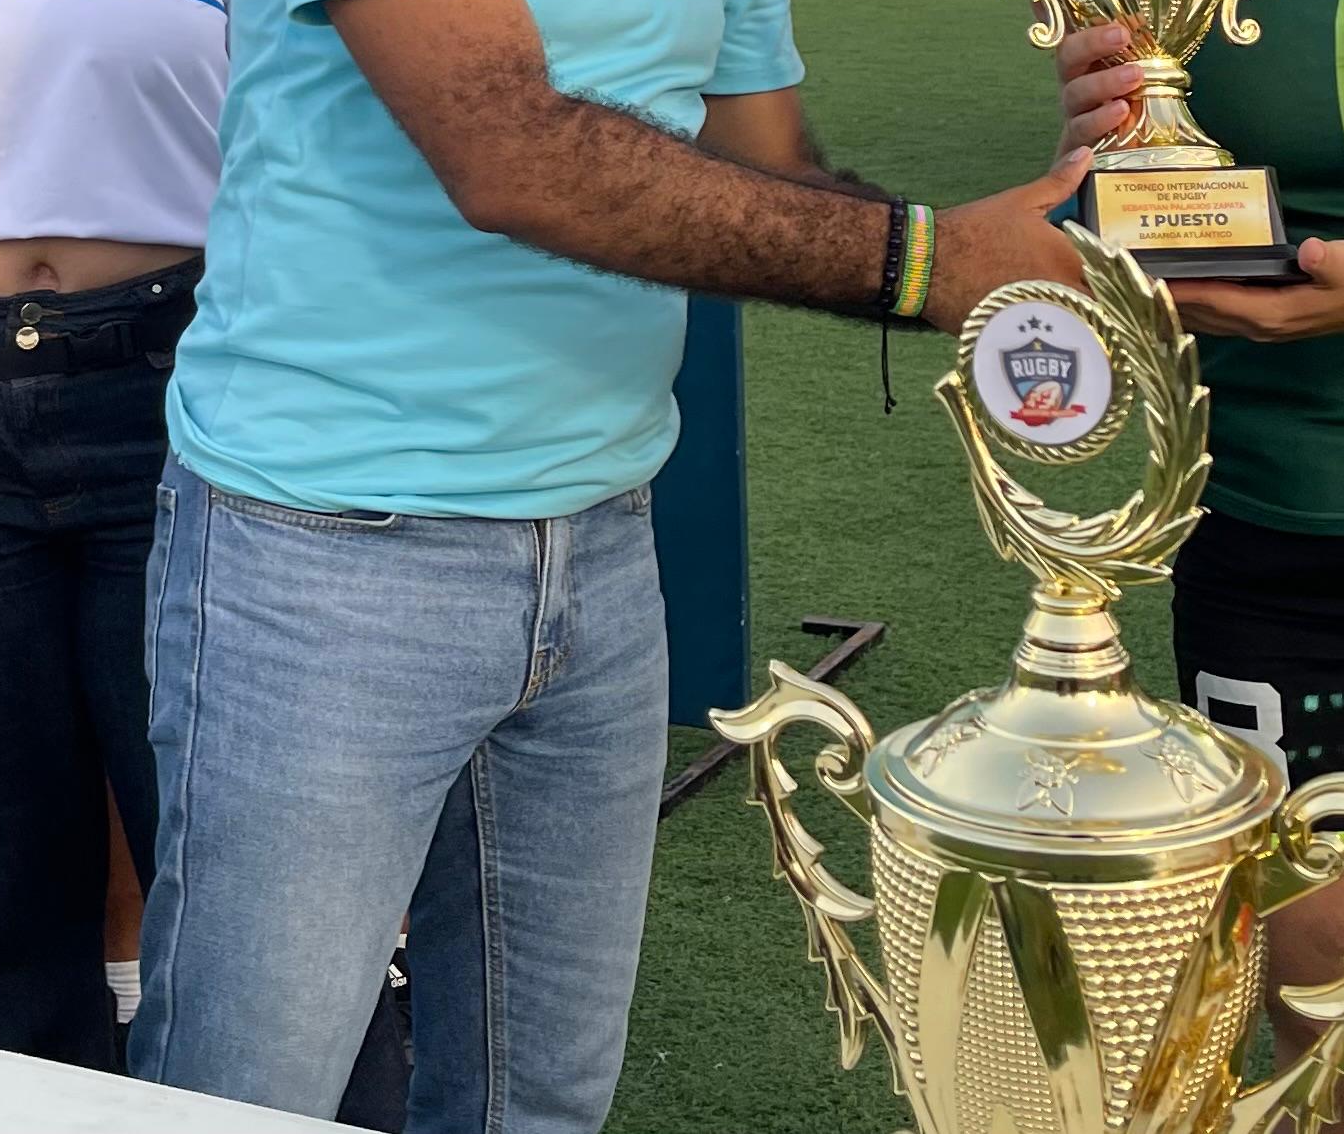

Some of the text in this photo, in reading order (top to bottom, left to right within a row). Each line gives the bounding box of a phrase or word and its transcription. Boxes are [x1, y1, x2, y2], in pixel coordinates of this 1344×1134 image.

[1123, 182, 1165, 192] TORNEO
[1167, 180, 1248, 191] INTERNACIONAL
[1157, 192, 1207, 201] DE RUGBY
[1155, 213, 1229, 227] PUESTO
[1010, 356, 1072, 379] RUGBY
